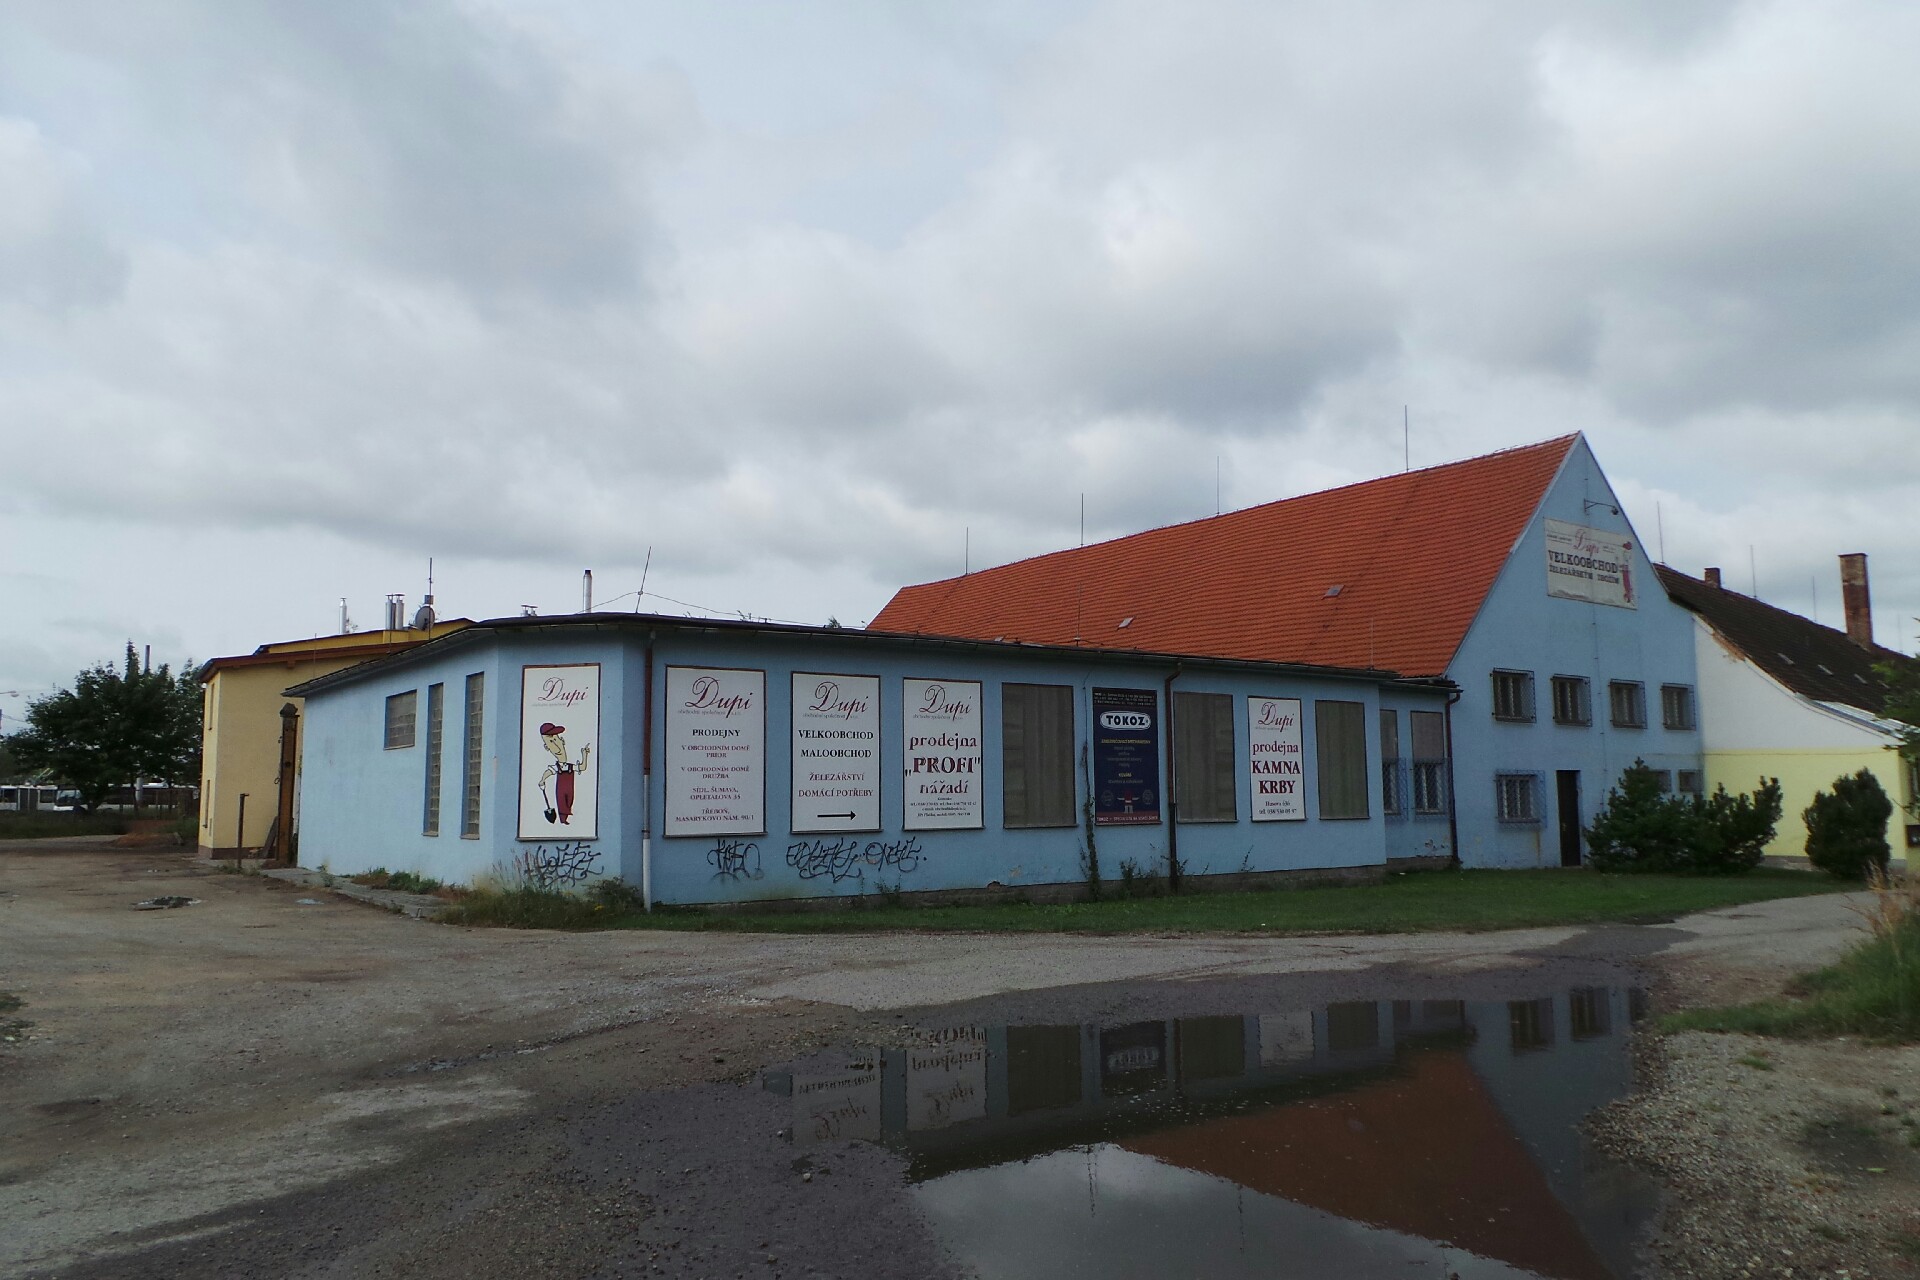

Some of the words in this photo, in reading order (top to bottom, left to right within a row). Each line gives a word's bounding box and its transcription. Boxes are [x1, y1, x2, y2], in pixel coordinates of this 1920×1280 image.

[1548, 549, 1618, 573] VELKOOBCHOD
[538, 676, 588, 707] Dupi
[685, 676, 753, 718] Dupi
[809, 681, 869, 720] Dupi
[919, 684, 972, 721] Dupi
[1105, 715, 1146, 726] TOKOZ
[1258, 701, 1295, 732] Dupi
[692, 729, 741, 738] PRODEJNY
[798, 730, 874, 739] VELKOOBCHOD
[909, 733, 977, 750] prodejna
[1252, 740, 1299, 756] prodejna
[800, 749, 872, 758] MALOOBCHOD
[1252, 760, 1301, 774] KAMNA
[809, 772, 865, 781] ŽELEZÁŘSTVÍ
[798, 788, 835, 797] DOMÁCÍ
[836, 788, 874, 797] POTŘEBY
[920, 780, 969, 793] nářadí
[1259, 780, 1296, 794] KRBY
